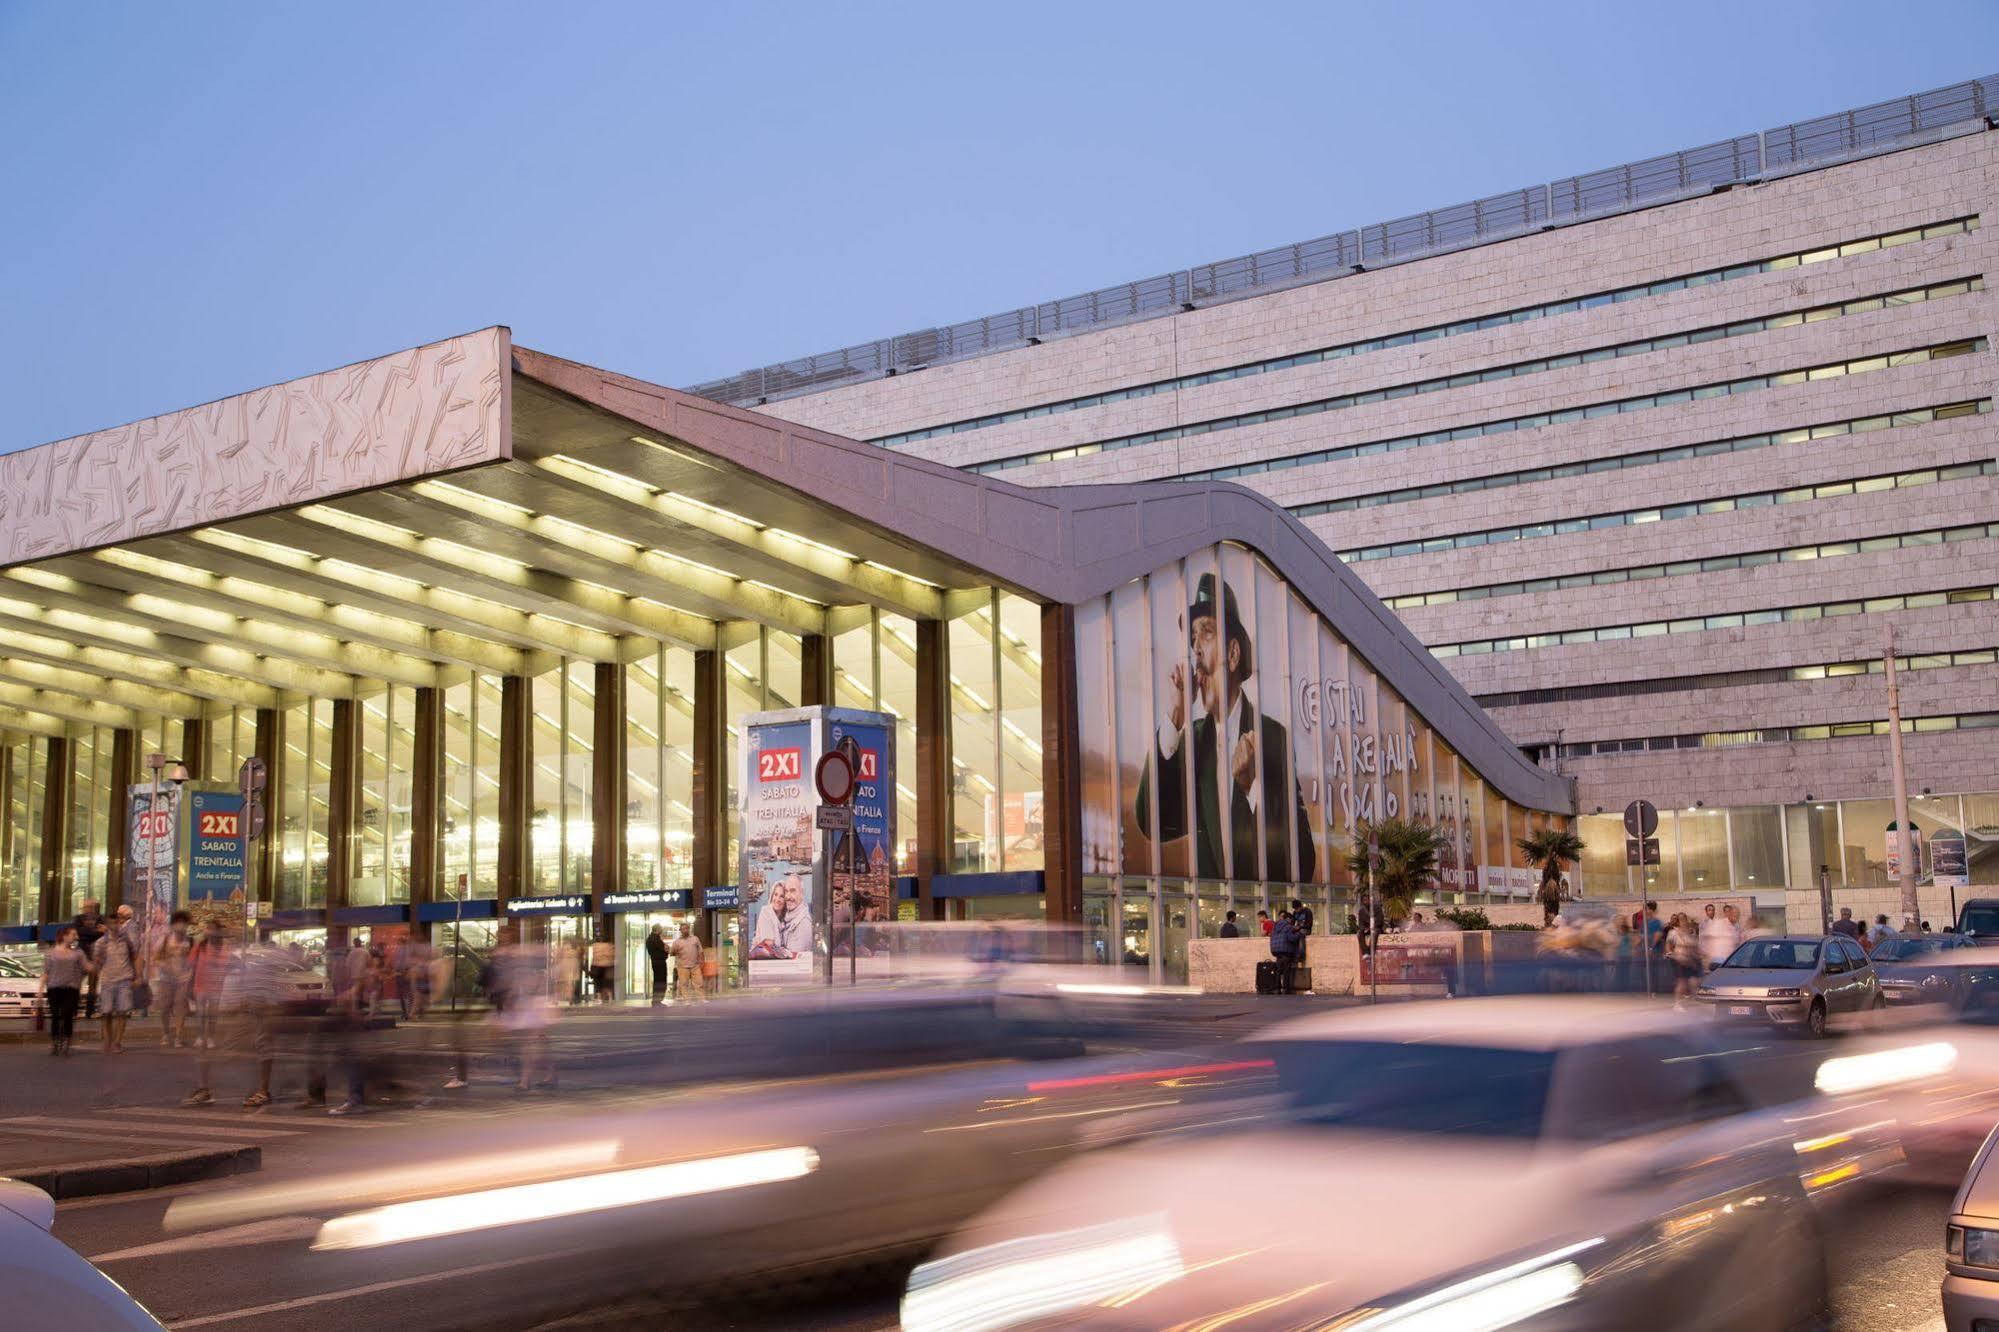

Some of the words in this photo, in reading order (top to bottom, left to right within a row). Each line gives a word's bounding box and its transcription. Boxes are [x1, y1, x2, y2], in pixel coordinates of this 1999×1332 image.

[1333, 734, 1346, 777] A
[760, 752, 799, 778] 2X1
[860, 753, 876, 777] X1
[761, 785, 800, 800] SABATO
[756, 806, 807, 820] TRENITALIA
[202, 815, 238, 835] 2X1
[861, 824, 881, 834] Firenze
[201, 841, 237, 852] SABATO
[193, 856, 243, 867] TRENITALIA
[220, 872, 241, 880] Firenze
[706, 888, 736, 898] Terminal
